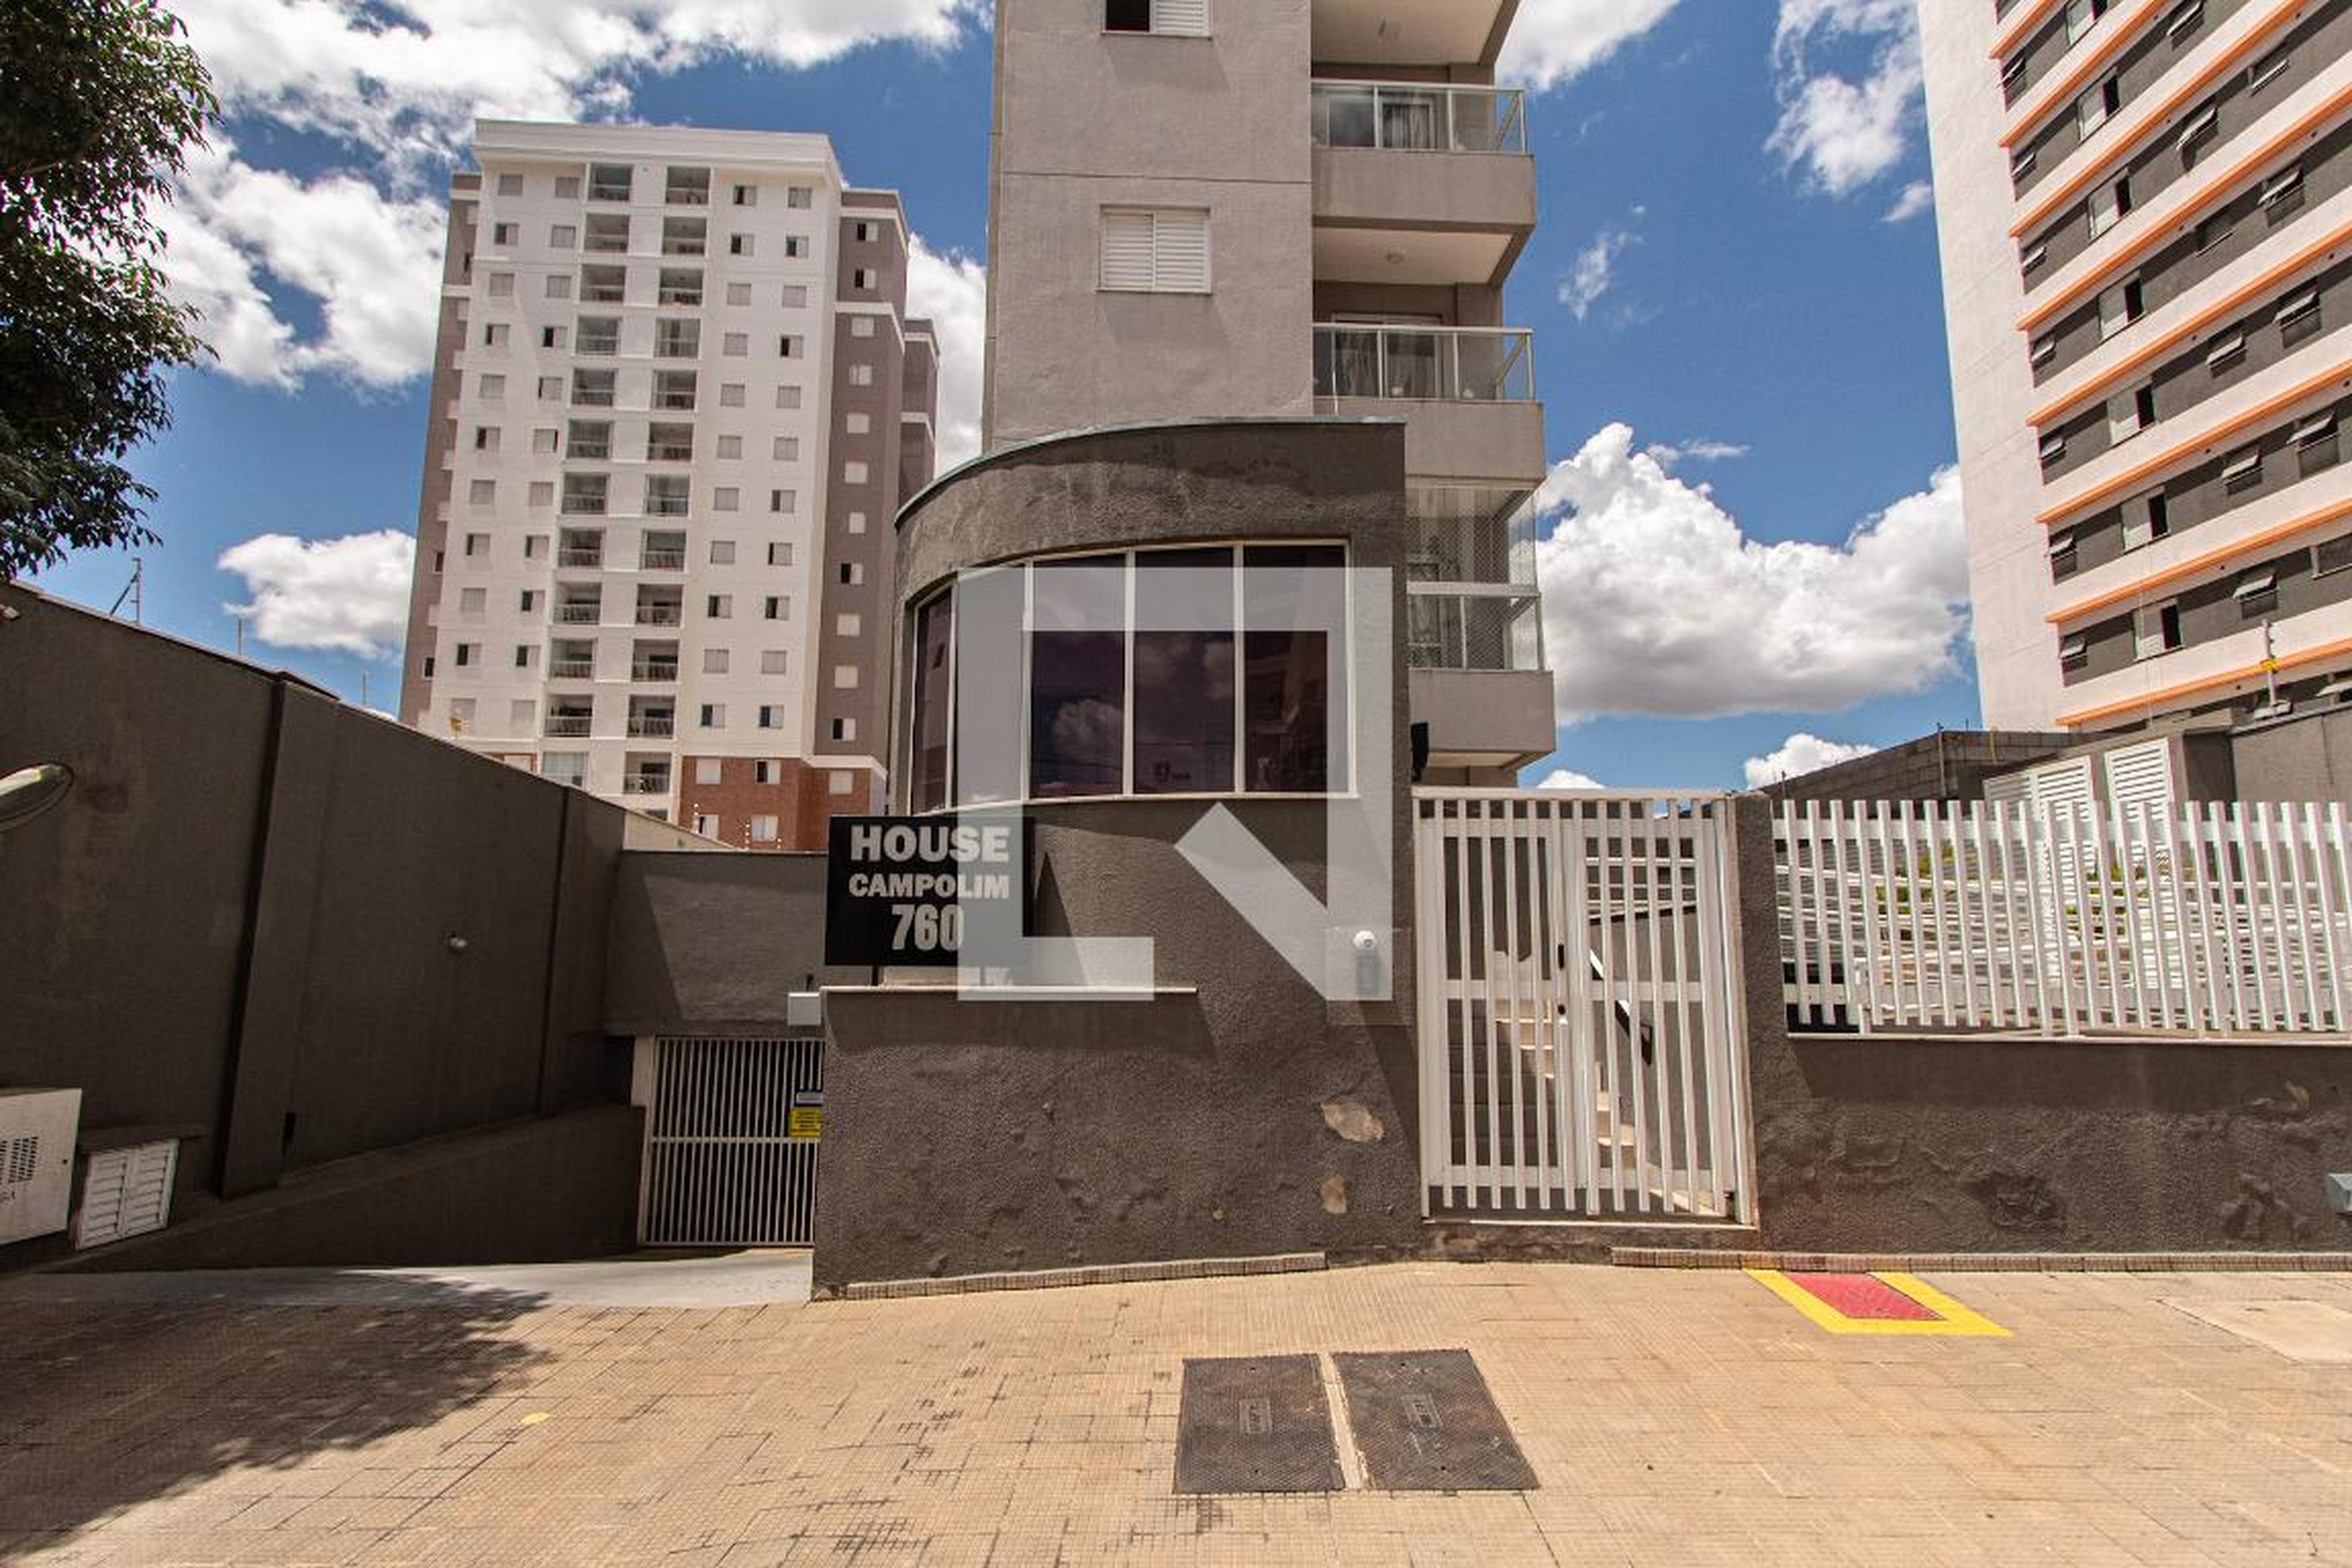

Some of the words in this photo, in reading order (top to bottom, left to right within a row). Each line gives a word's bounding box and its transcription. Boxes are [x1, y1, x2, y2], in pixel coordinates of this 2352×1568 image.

[851, 824, 1010, 862] HOUSE
[848, 872, 1010, 899] CAMPOLIM
[891, 903, 965, 951] 760
